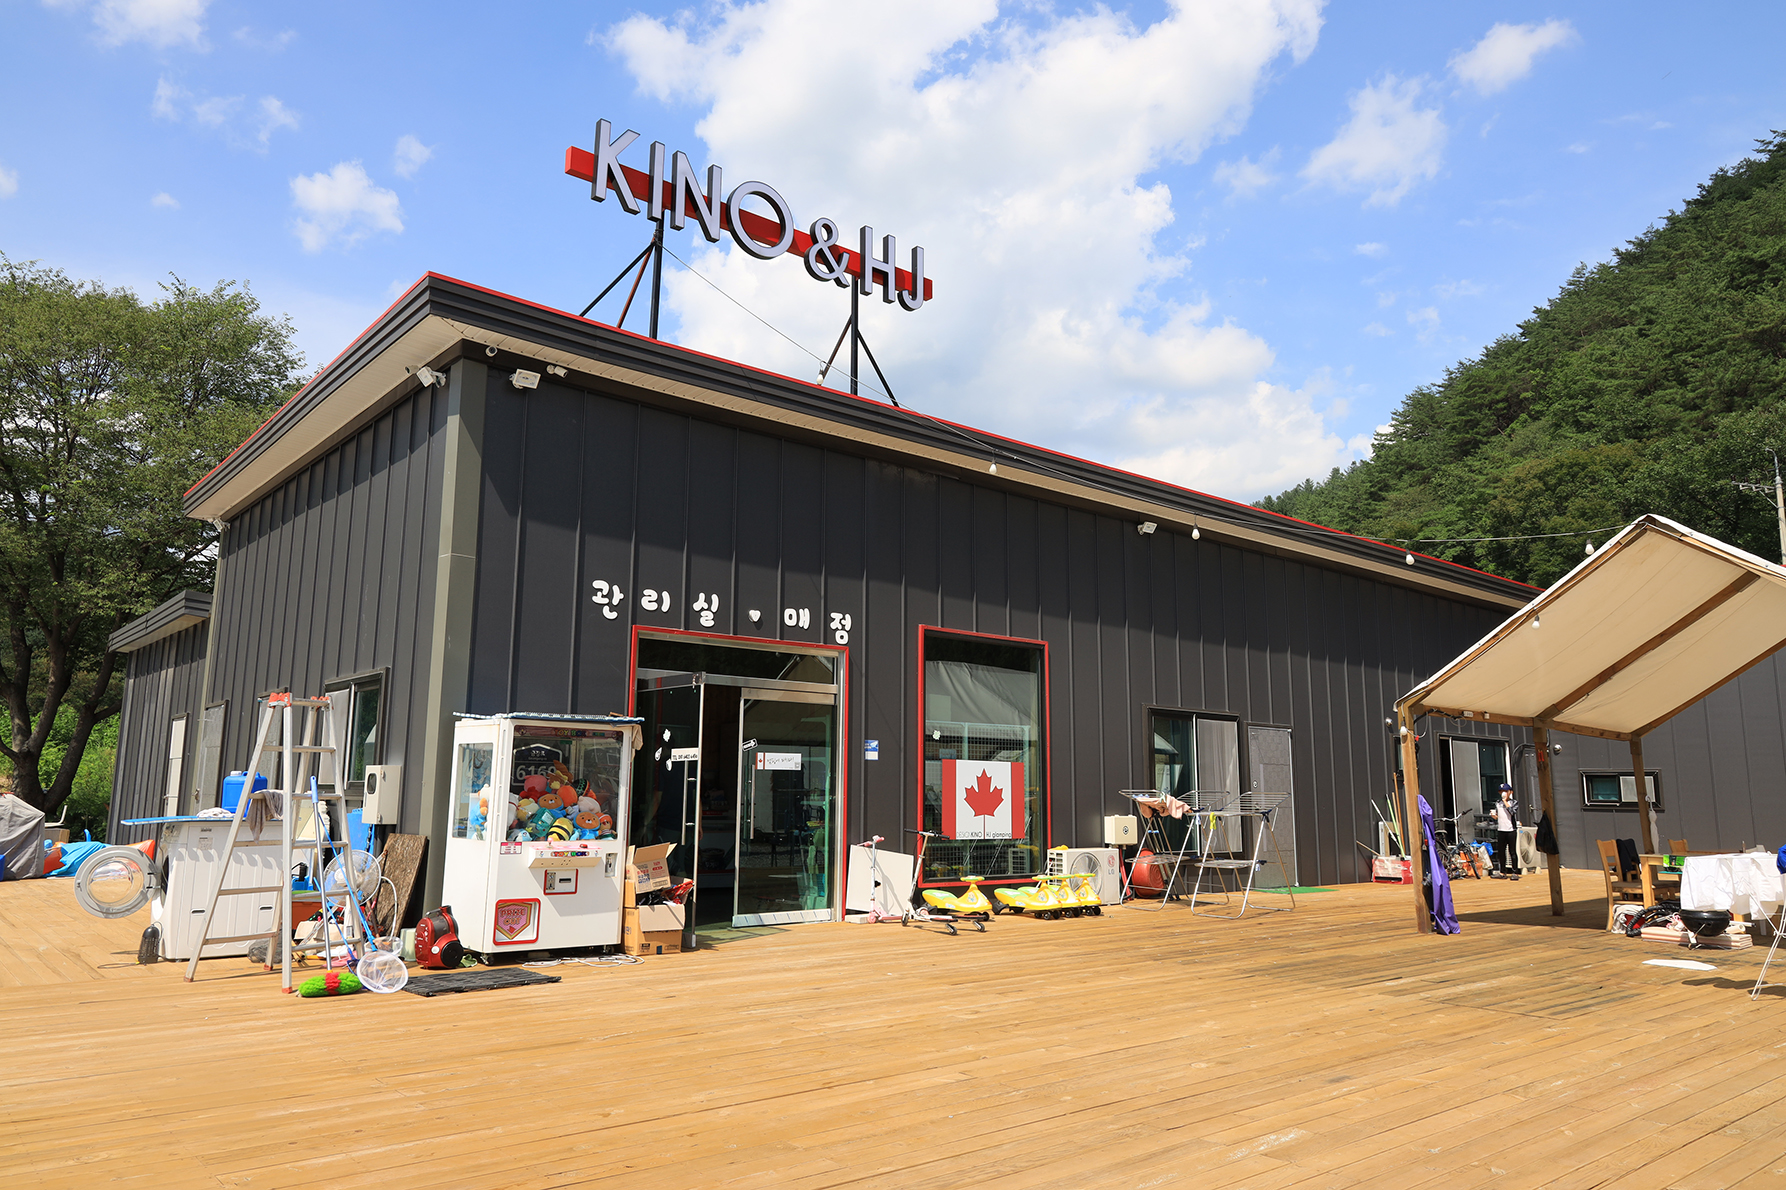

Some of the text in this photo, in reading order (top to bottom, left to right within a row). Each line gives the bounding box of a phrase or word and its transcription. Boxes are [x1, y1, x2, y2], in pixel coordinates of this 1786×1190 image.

[591, 118, 925, 312] KINO & HJ
[592, 580, 720, 628] 관리실
[500, 908, 526, 917] PRIZE
[503, 917, 521, 926] OUT
